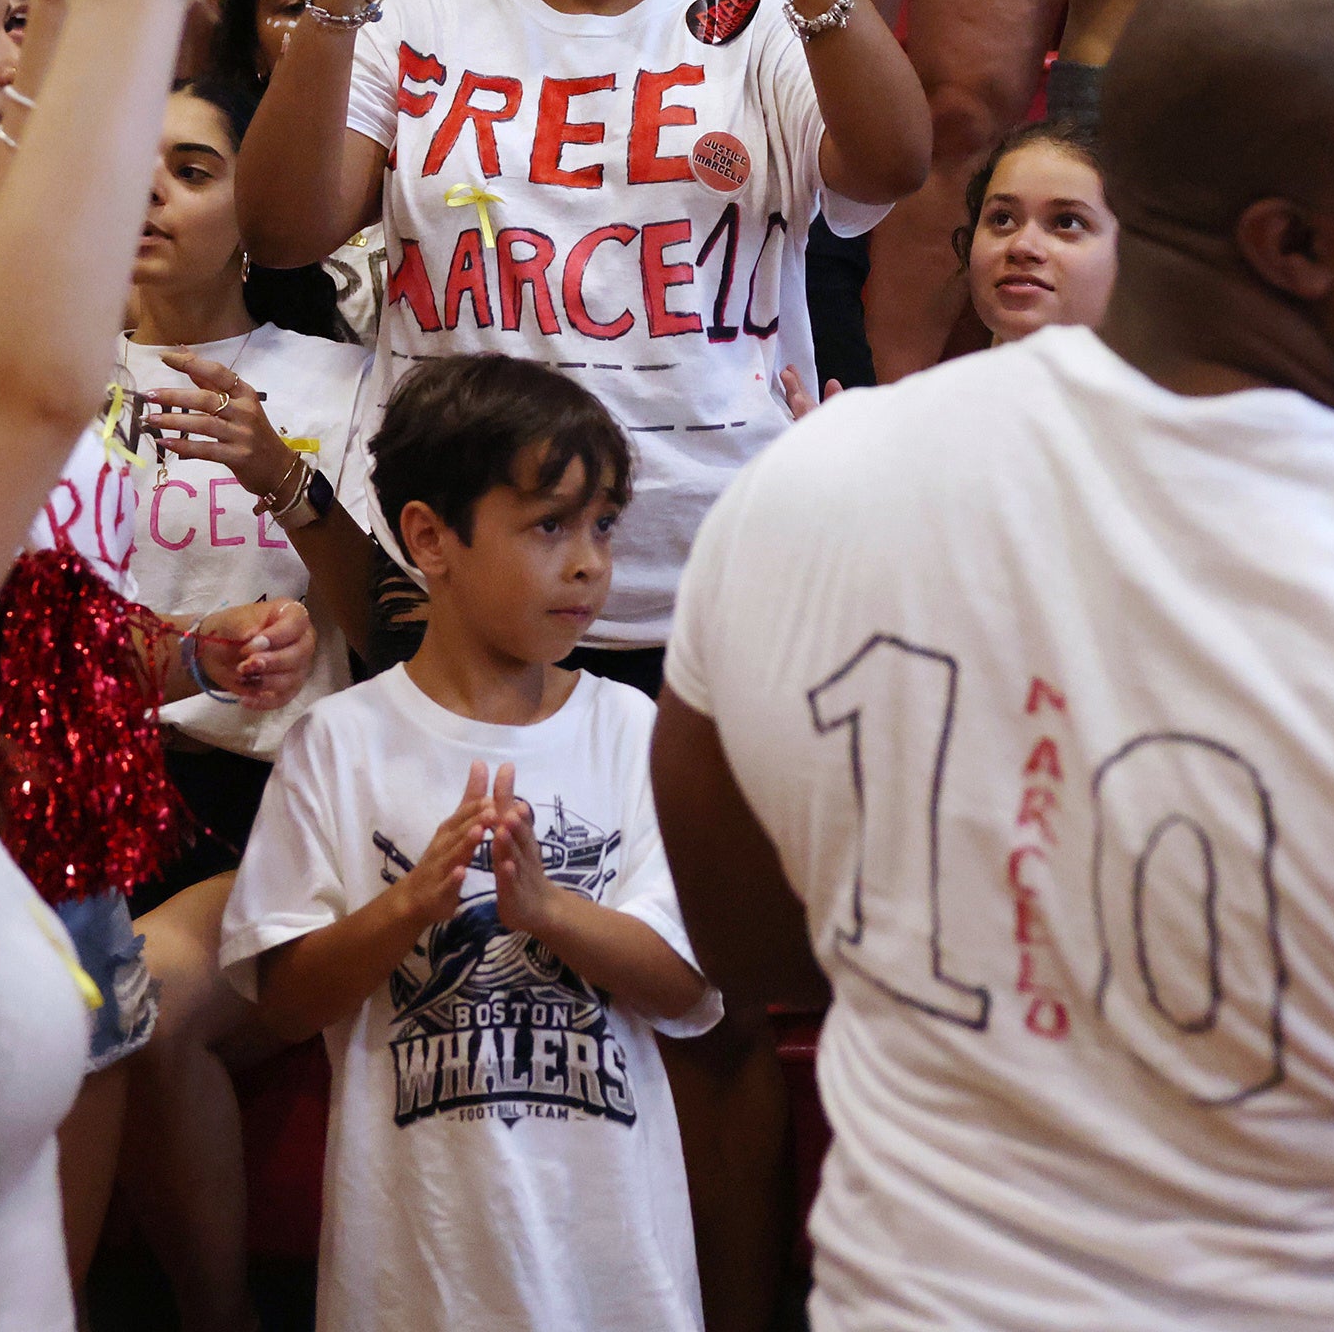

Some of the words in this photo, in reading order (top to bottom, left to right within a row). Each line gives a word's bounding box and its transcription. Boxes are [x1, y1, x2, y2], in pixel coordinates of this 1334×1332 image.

[388, 40, 706, 190] FREE
[703, 139, 747, 166] JUSTICE
[712, 151, 734, 168] FOR
[694, 153, 744, 185] MARCELO
[454, 1001, 569, 1028] BOSTON
[395, 1027, 636, 1118] WHALERS
[526, 1103, 569, 1121] TEAM
